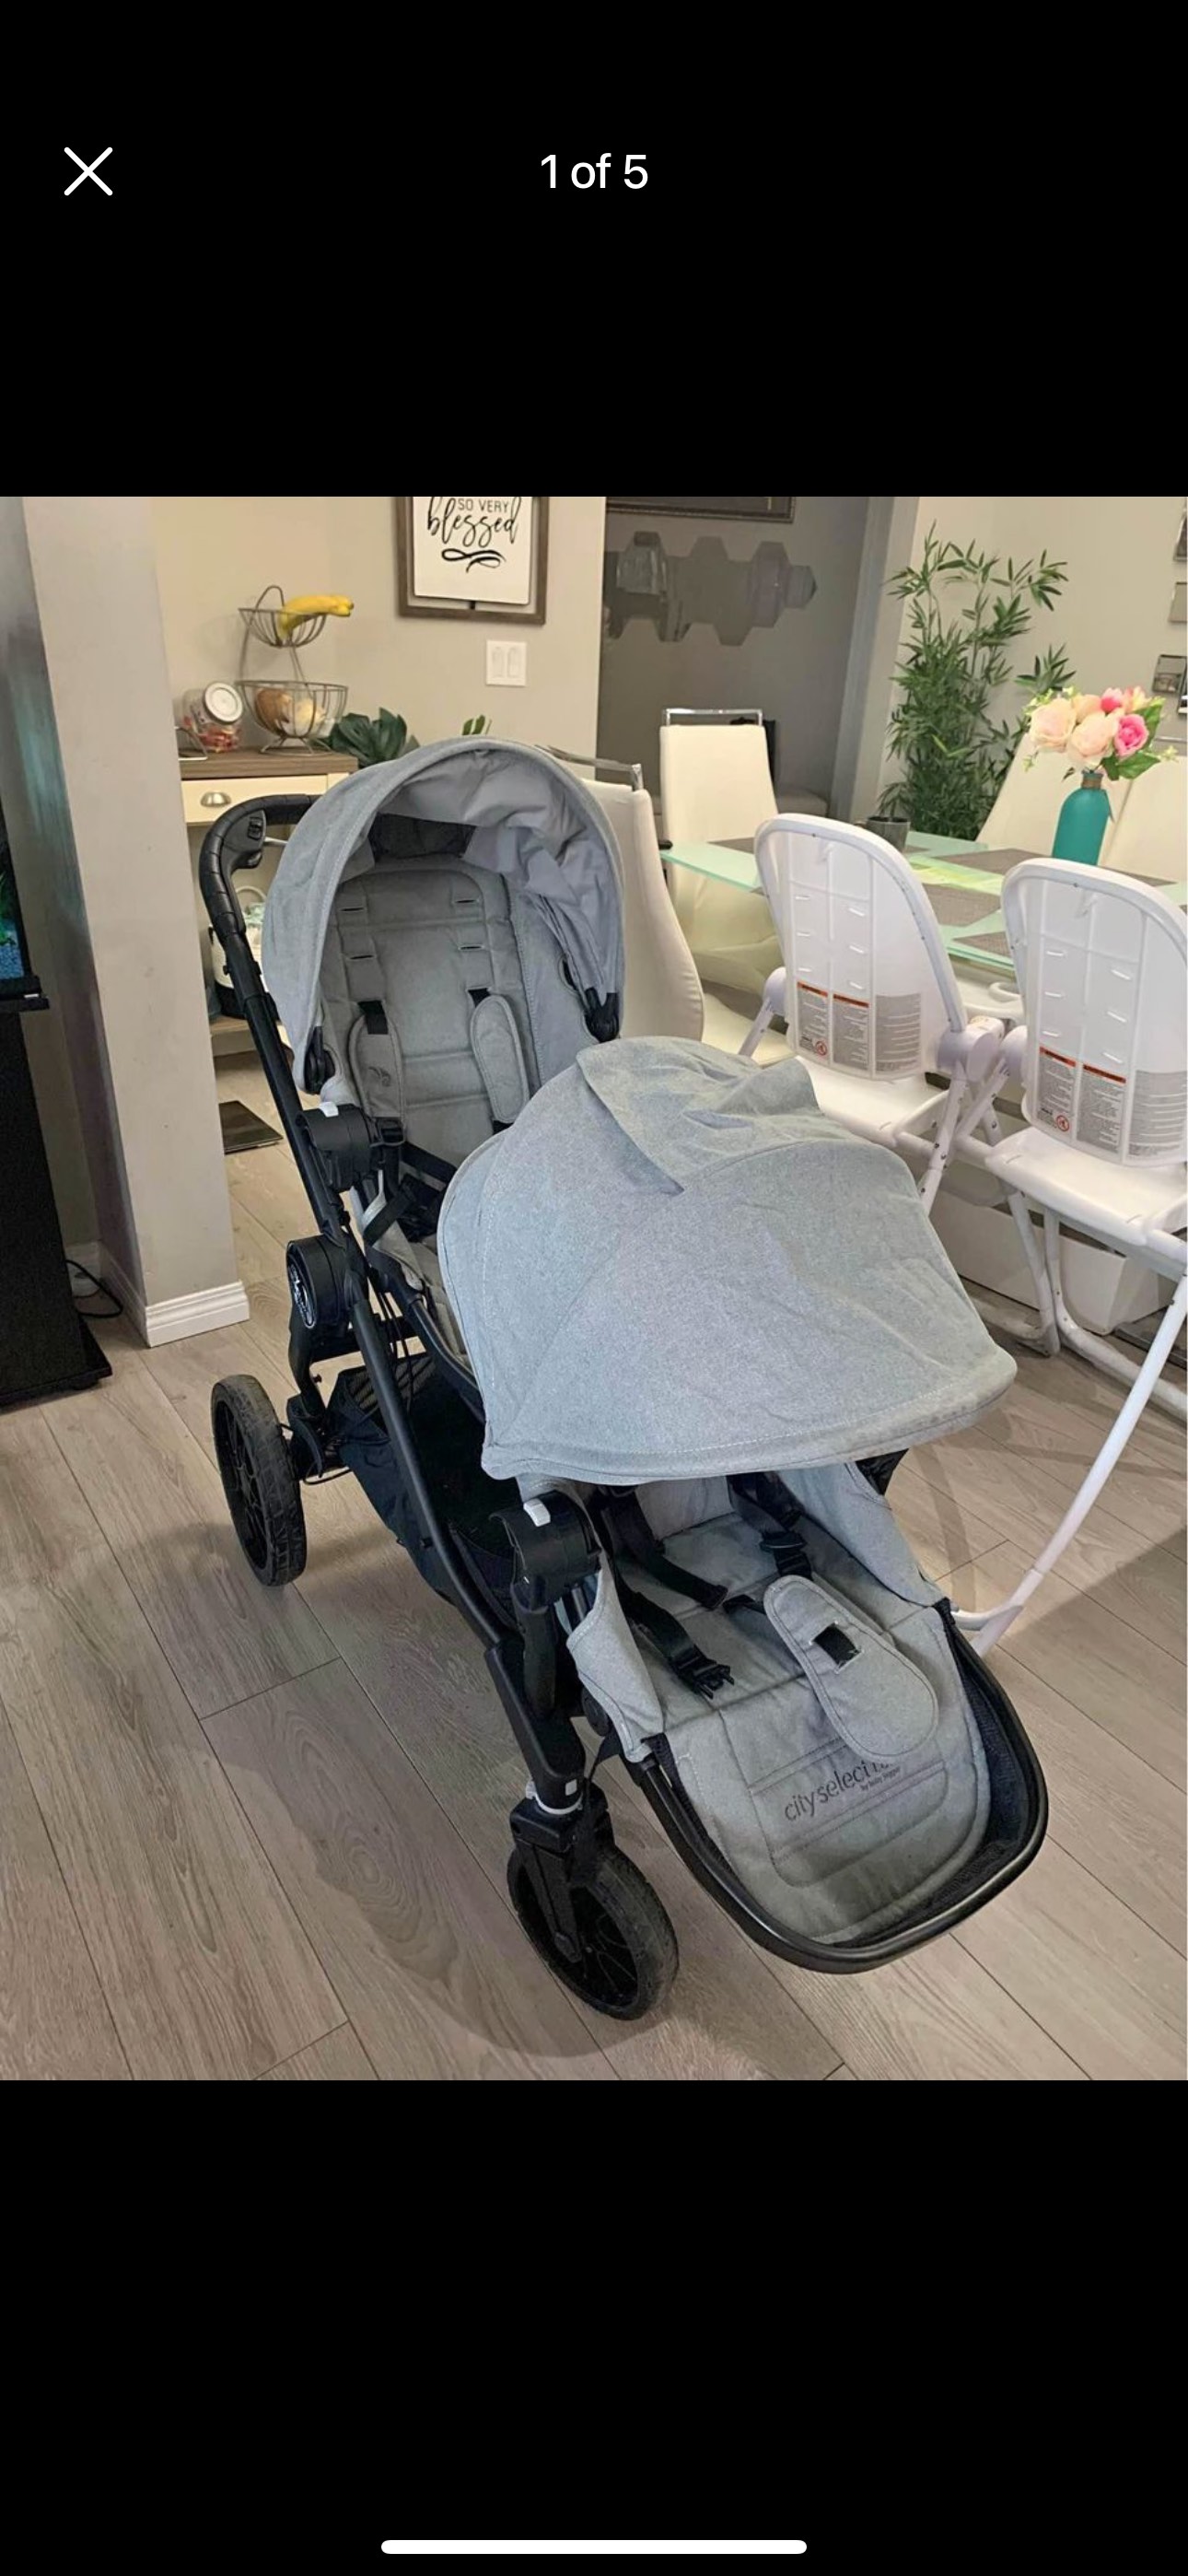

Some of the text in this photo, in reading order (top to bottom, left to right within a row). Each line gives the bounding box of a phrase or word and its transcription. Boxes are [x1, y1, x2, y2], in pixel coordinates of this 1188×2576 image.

[457, 498, 509, 513] SO VERY
[427, 497, 521, 547] blessed
